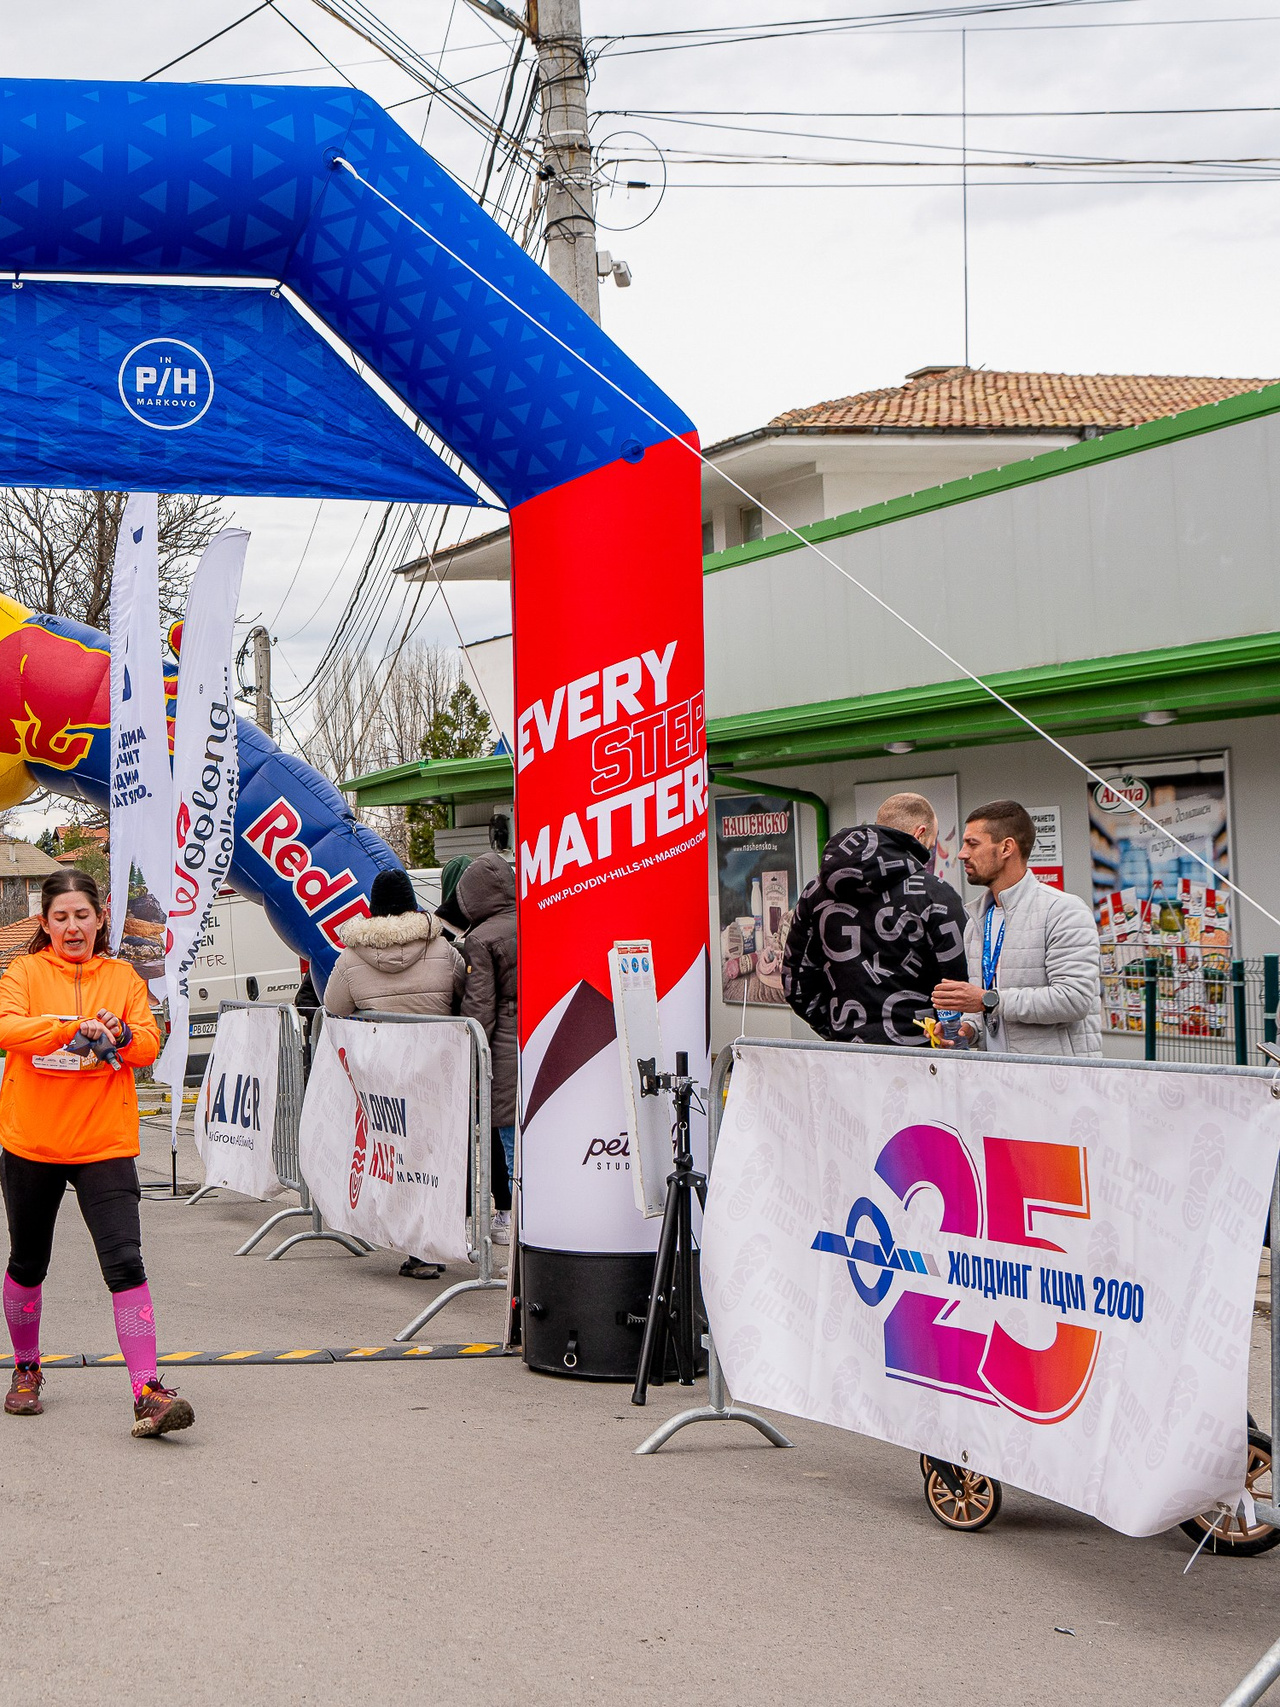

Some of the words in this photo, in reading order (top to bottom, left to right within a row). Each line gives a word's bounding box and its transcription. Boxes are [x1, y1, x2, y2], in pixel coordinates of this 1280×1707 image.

[136, 366, 196, 396] P/H
[159, 356, 172, 364] IN
[136, 398, 196, 408] MARKOVO
[517, 640, 678, 775] EVERY
[591, 689, 706, 796] STEP
[521, 749, 708, 901] MATTER
[722, 811, 788, 838] НАШЕНСКО
[244, 797, 356, 914] Red
[537, 829, 706, 911] WWW.PLOVDIV-HILLS-IN-MARKOVO.COM
[267, 983, 299, 993] DUCATO
[596, 1162, 630, 1171] STUD
[948, 1250, 1032, 1300] ХОЛДИНГ
[1040, 1267, 1086, 1315] КЦМ
[1093, 1276, 1144, 1324] 2000
